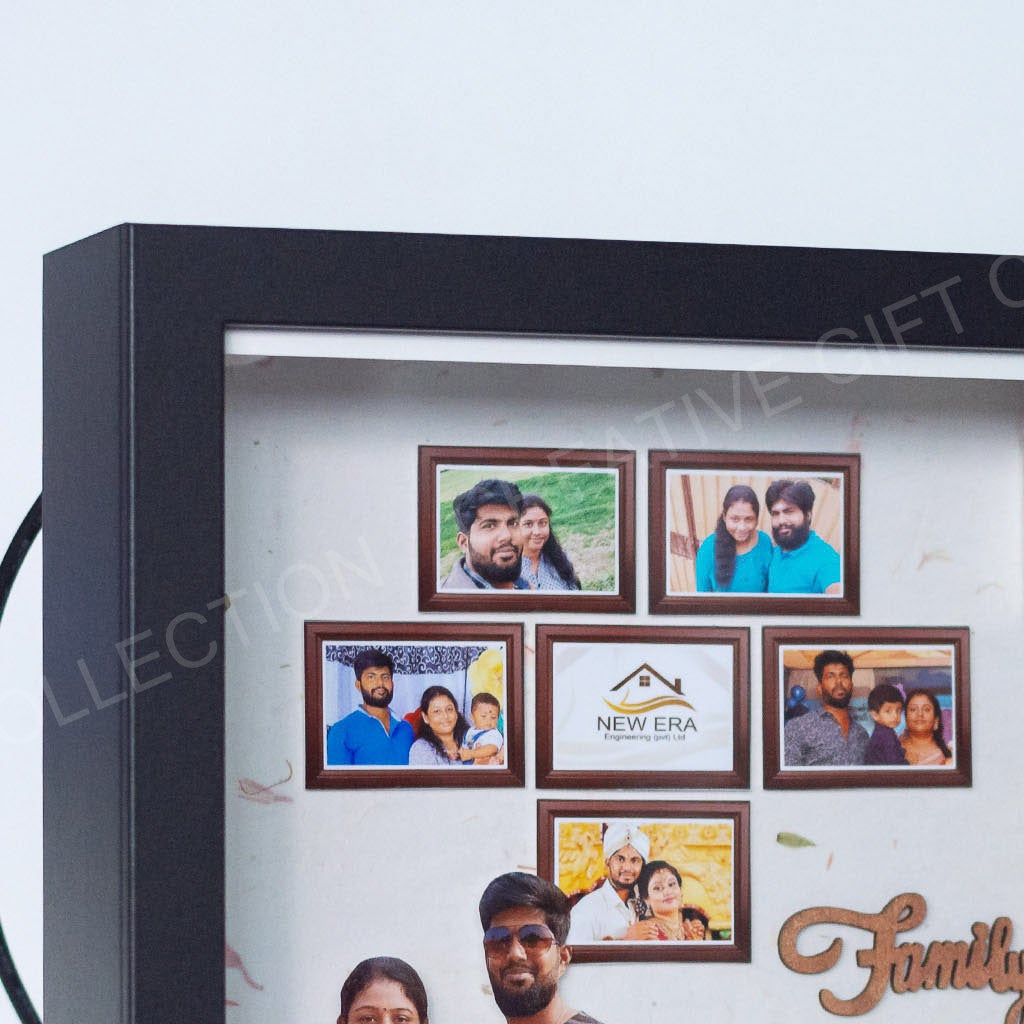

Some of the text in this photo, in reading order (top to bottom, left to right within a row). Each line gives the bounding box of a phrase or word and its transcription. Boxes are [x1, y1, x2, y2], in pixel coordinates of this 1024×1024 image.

[597, 716, 698, 732] NEW ERA
[604, 733, 651, 742] Engineering
[673, 733, 686, 741] Ltd
